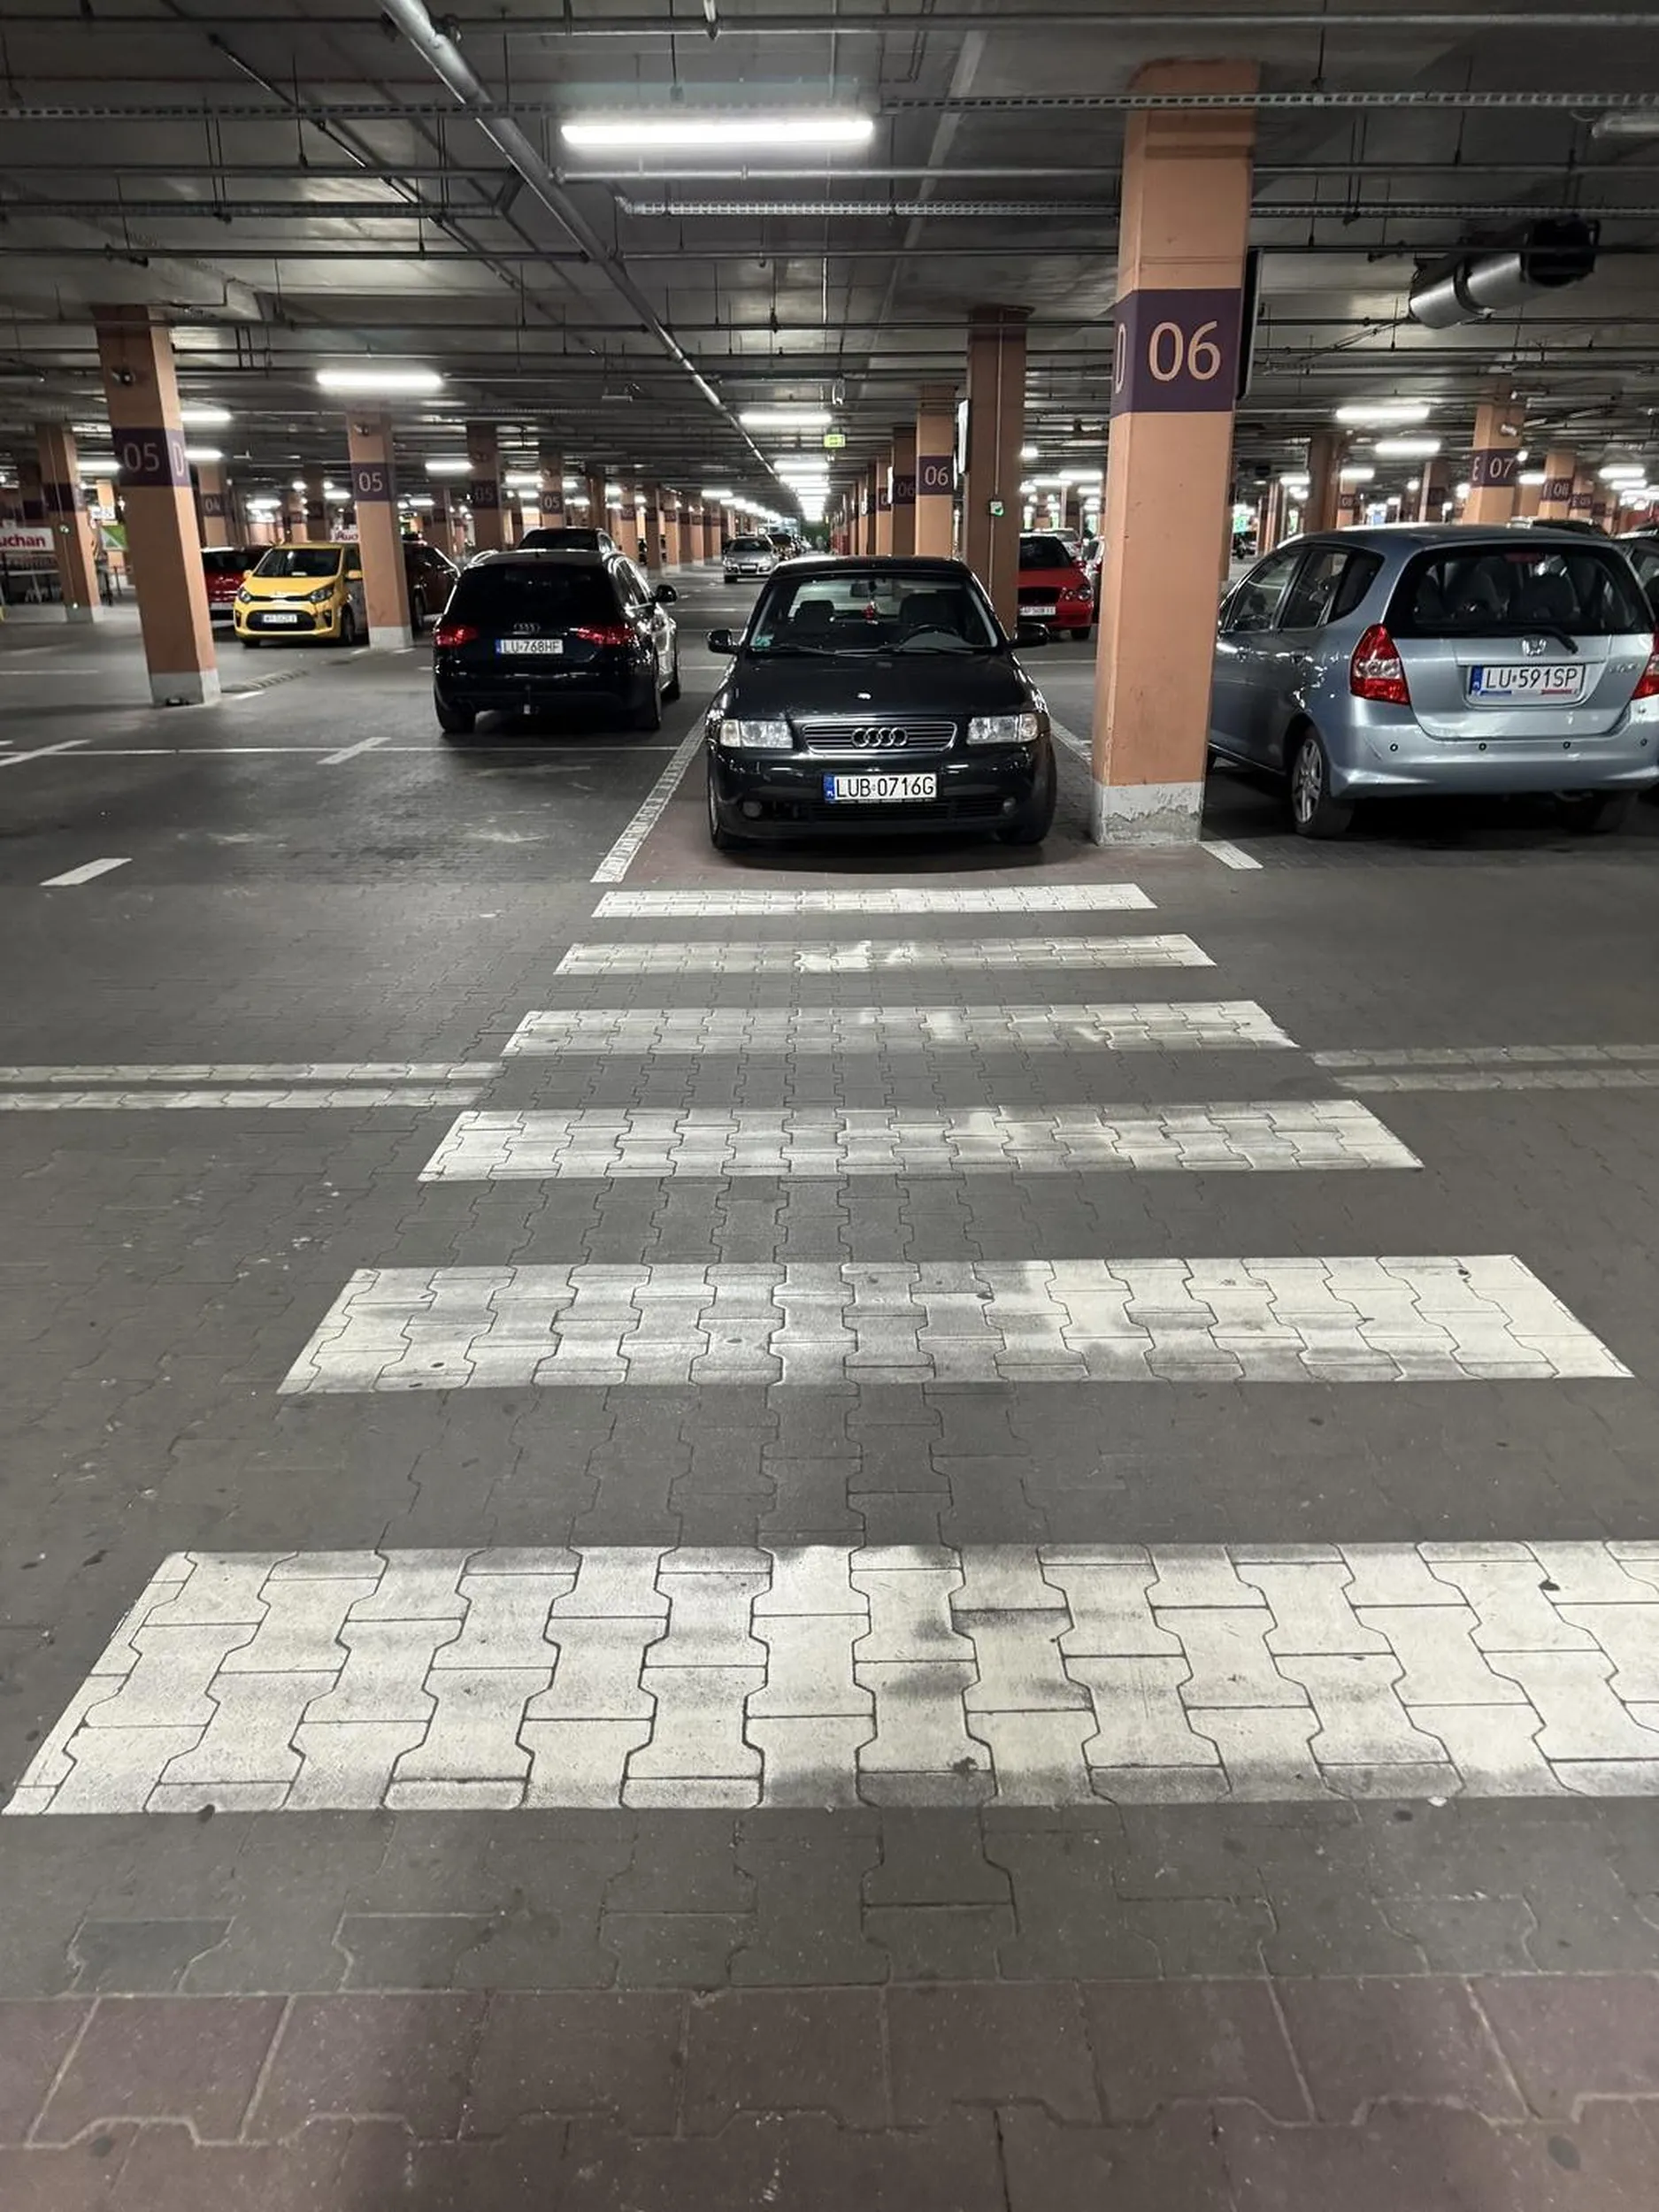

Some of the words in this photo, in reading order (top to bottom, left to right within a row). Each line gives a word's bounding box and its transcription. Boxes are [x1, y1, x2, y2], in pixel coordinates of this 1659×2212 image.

[1149, 321, 1221, 381] 06
[124, 442, 159, 472] 05
[1489, 457, 1515, 478] 07
[358, 472, 382, 492] 05
[925, 465, 949, 486] 06
[544, 498, 560, 510] 05
[836, 779, 871, 797] LUB
